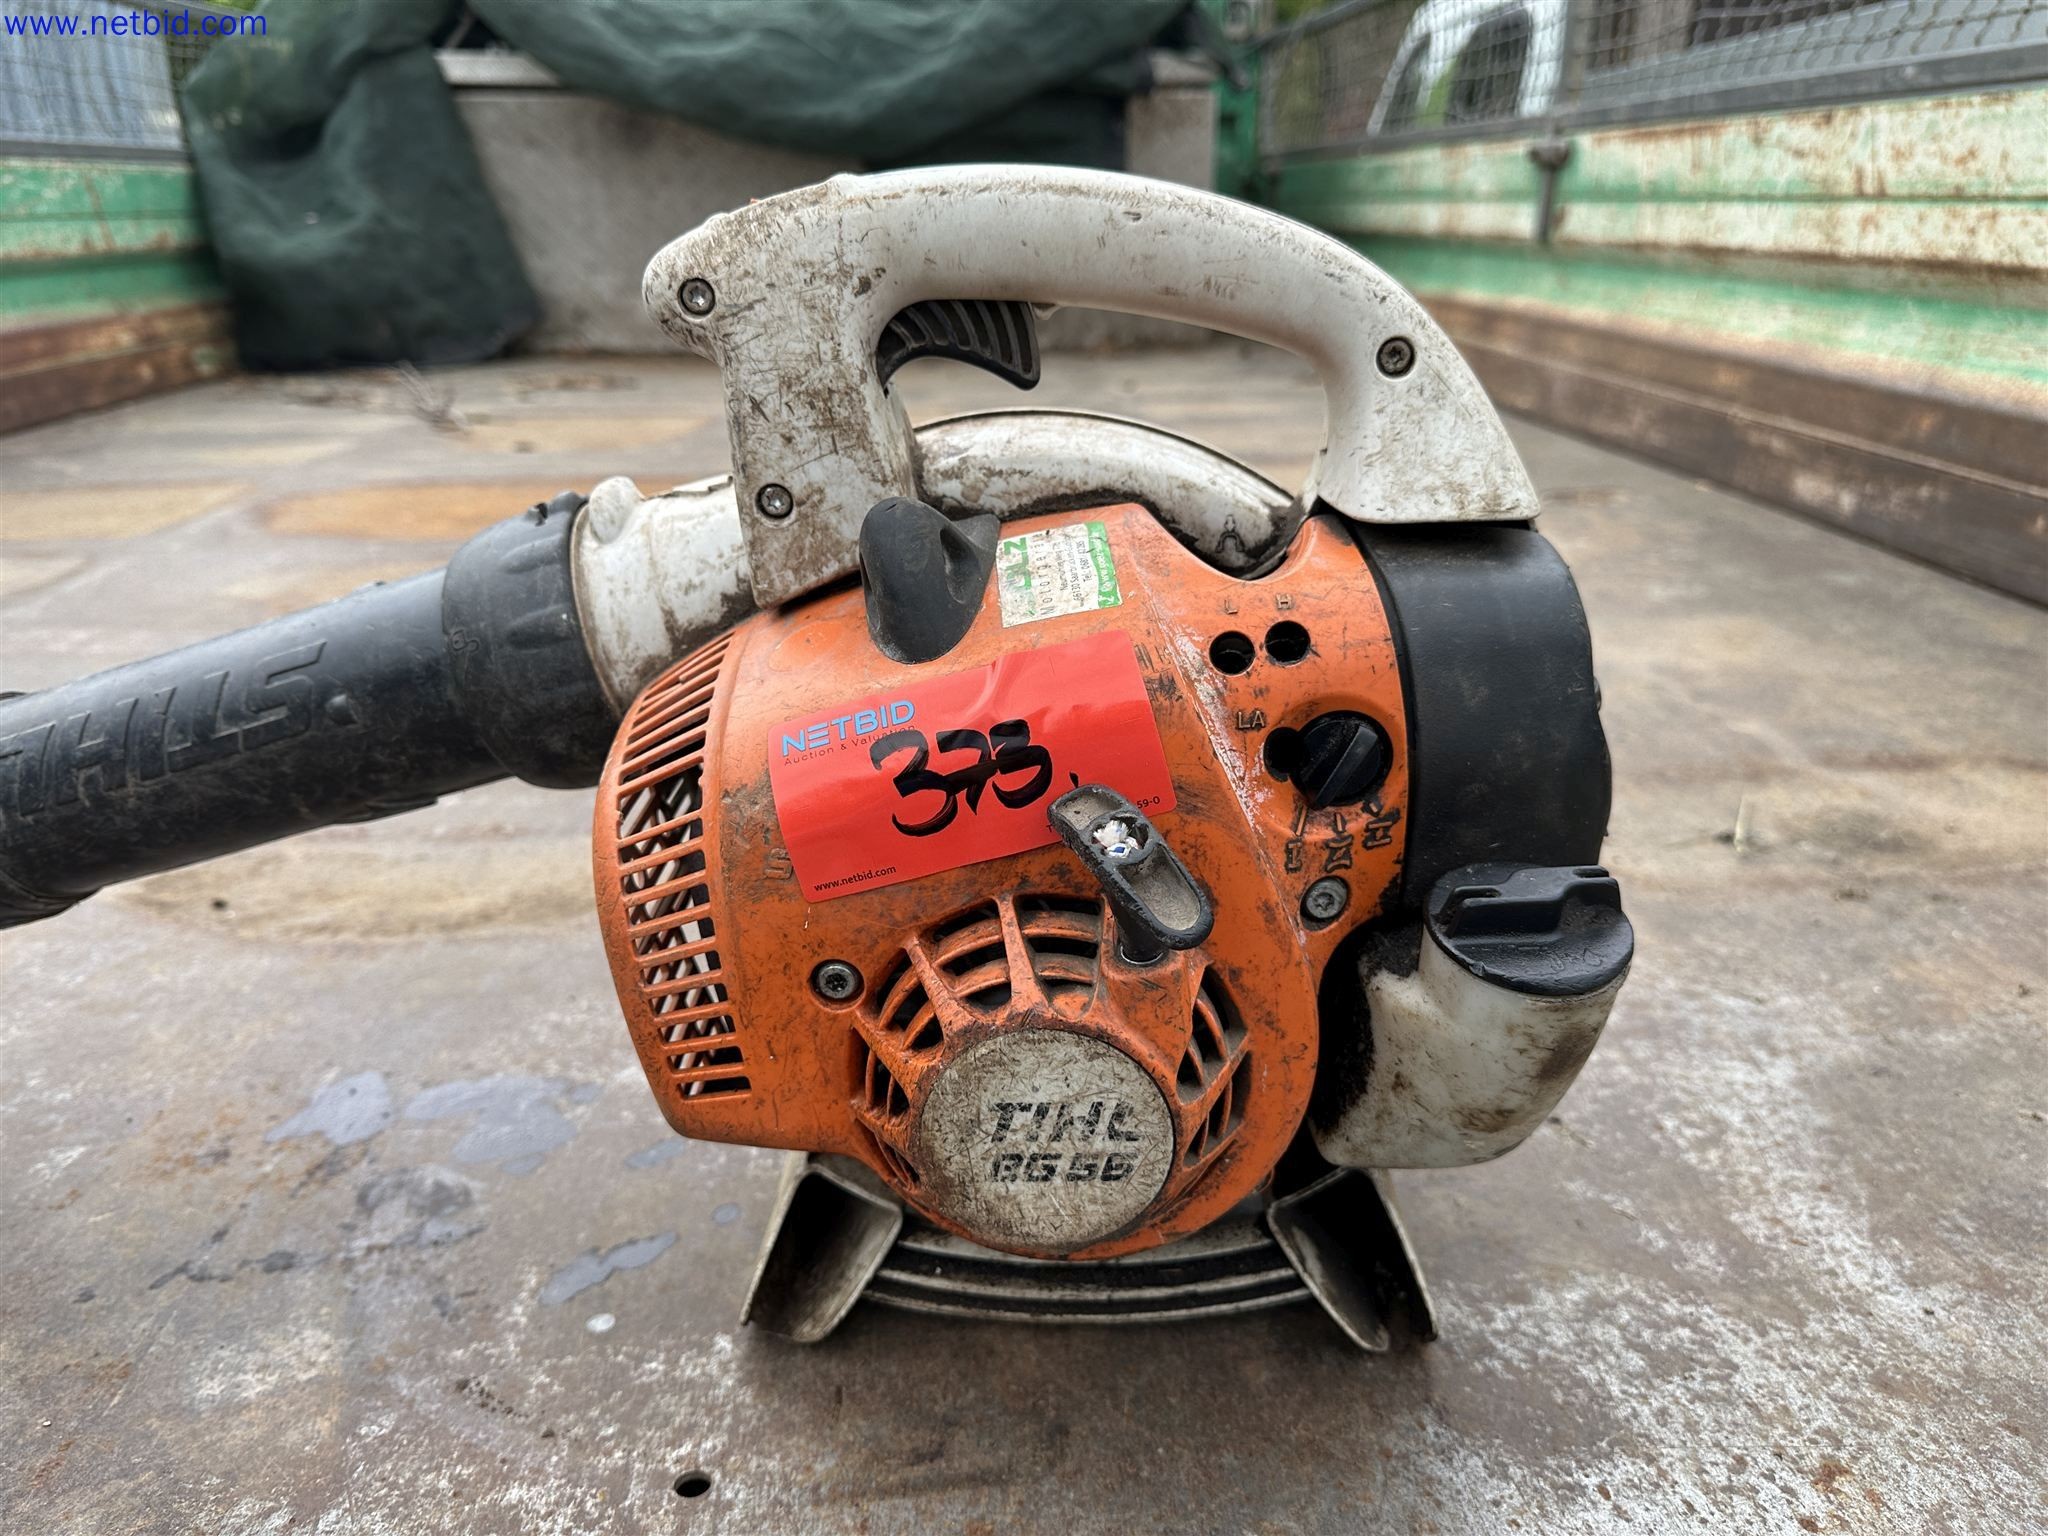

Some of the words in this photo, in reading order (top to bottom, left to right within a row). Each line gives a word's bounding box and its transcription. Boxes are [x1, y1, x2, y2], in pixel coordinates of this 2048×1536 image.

[782, 699, 916, 757] NETBID
[1237, 709, 1265, 730] LA
[784, 746, 834, 766] Auction
[813, 866, 897, 892] www.netbid.com
